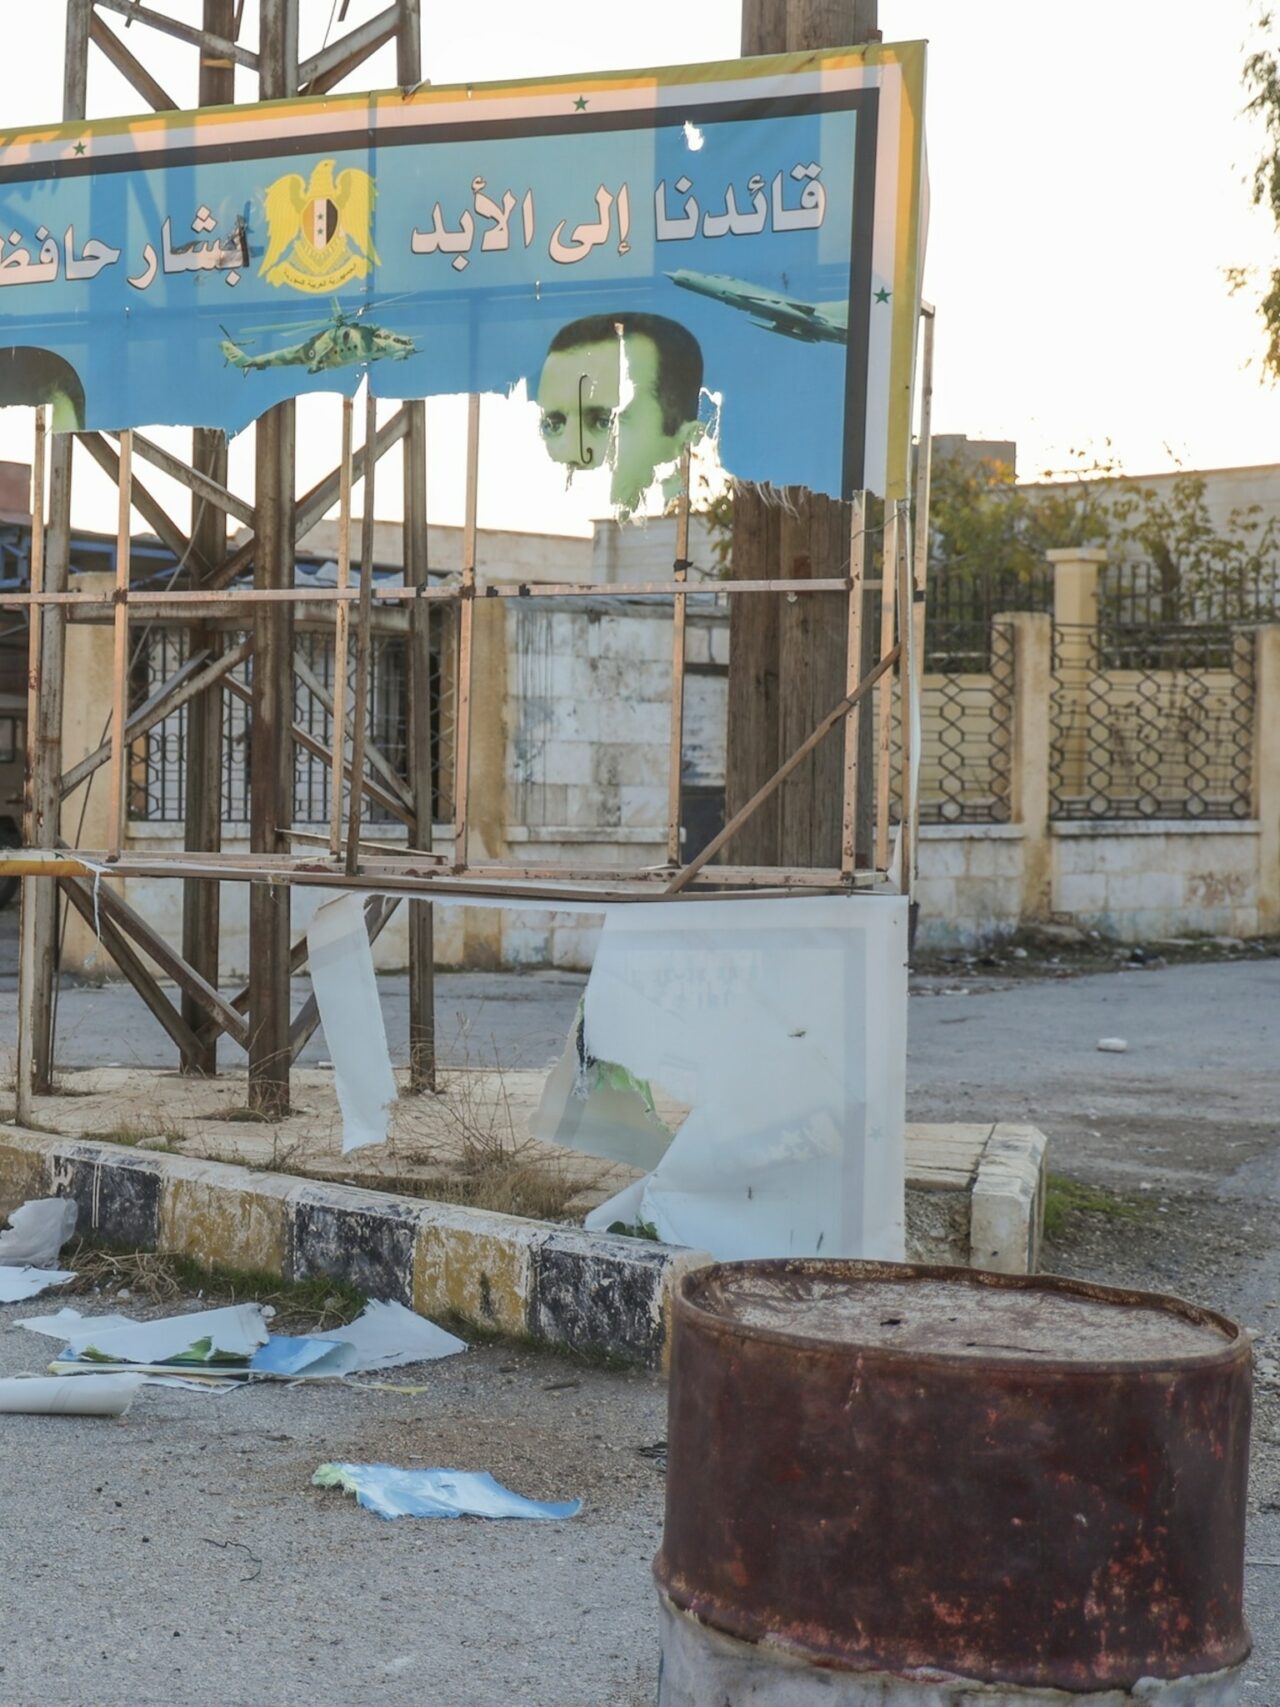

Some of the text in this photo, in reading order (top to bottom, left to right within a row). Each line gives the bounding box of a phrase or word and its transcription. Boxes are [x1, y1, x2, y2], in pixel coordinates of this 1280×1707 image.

[410, 175, 535, 272] الأبد
[548, 182, 632, 264] إلى
[654, 161, 828, 242] قائدنا
[126, 204, 247, 290] بشار
